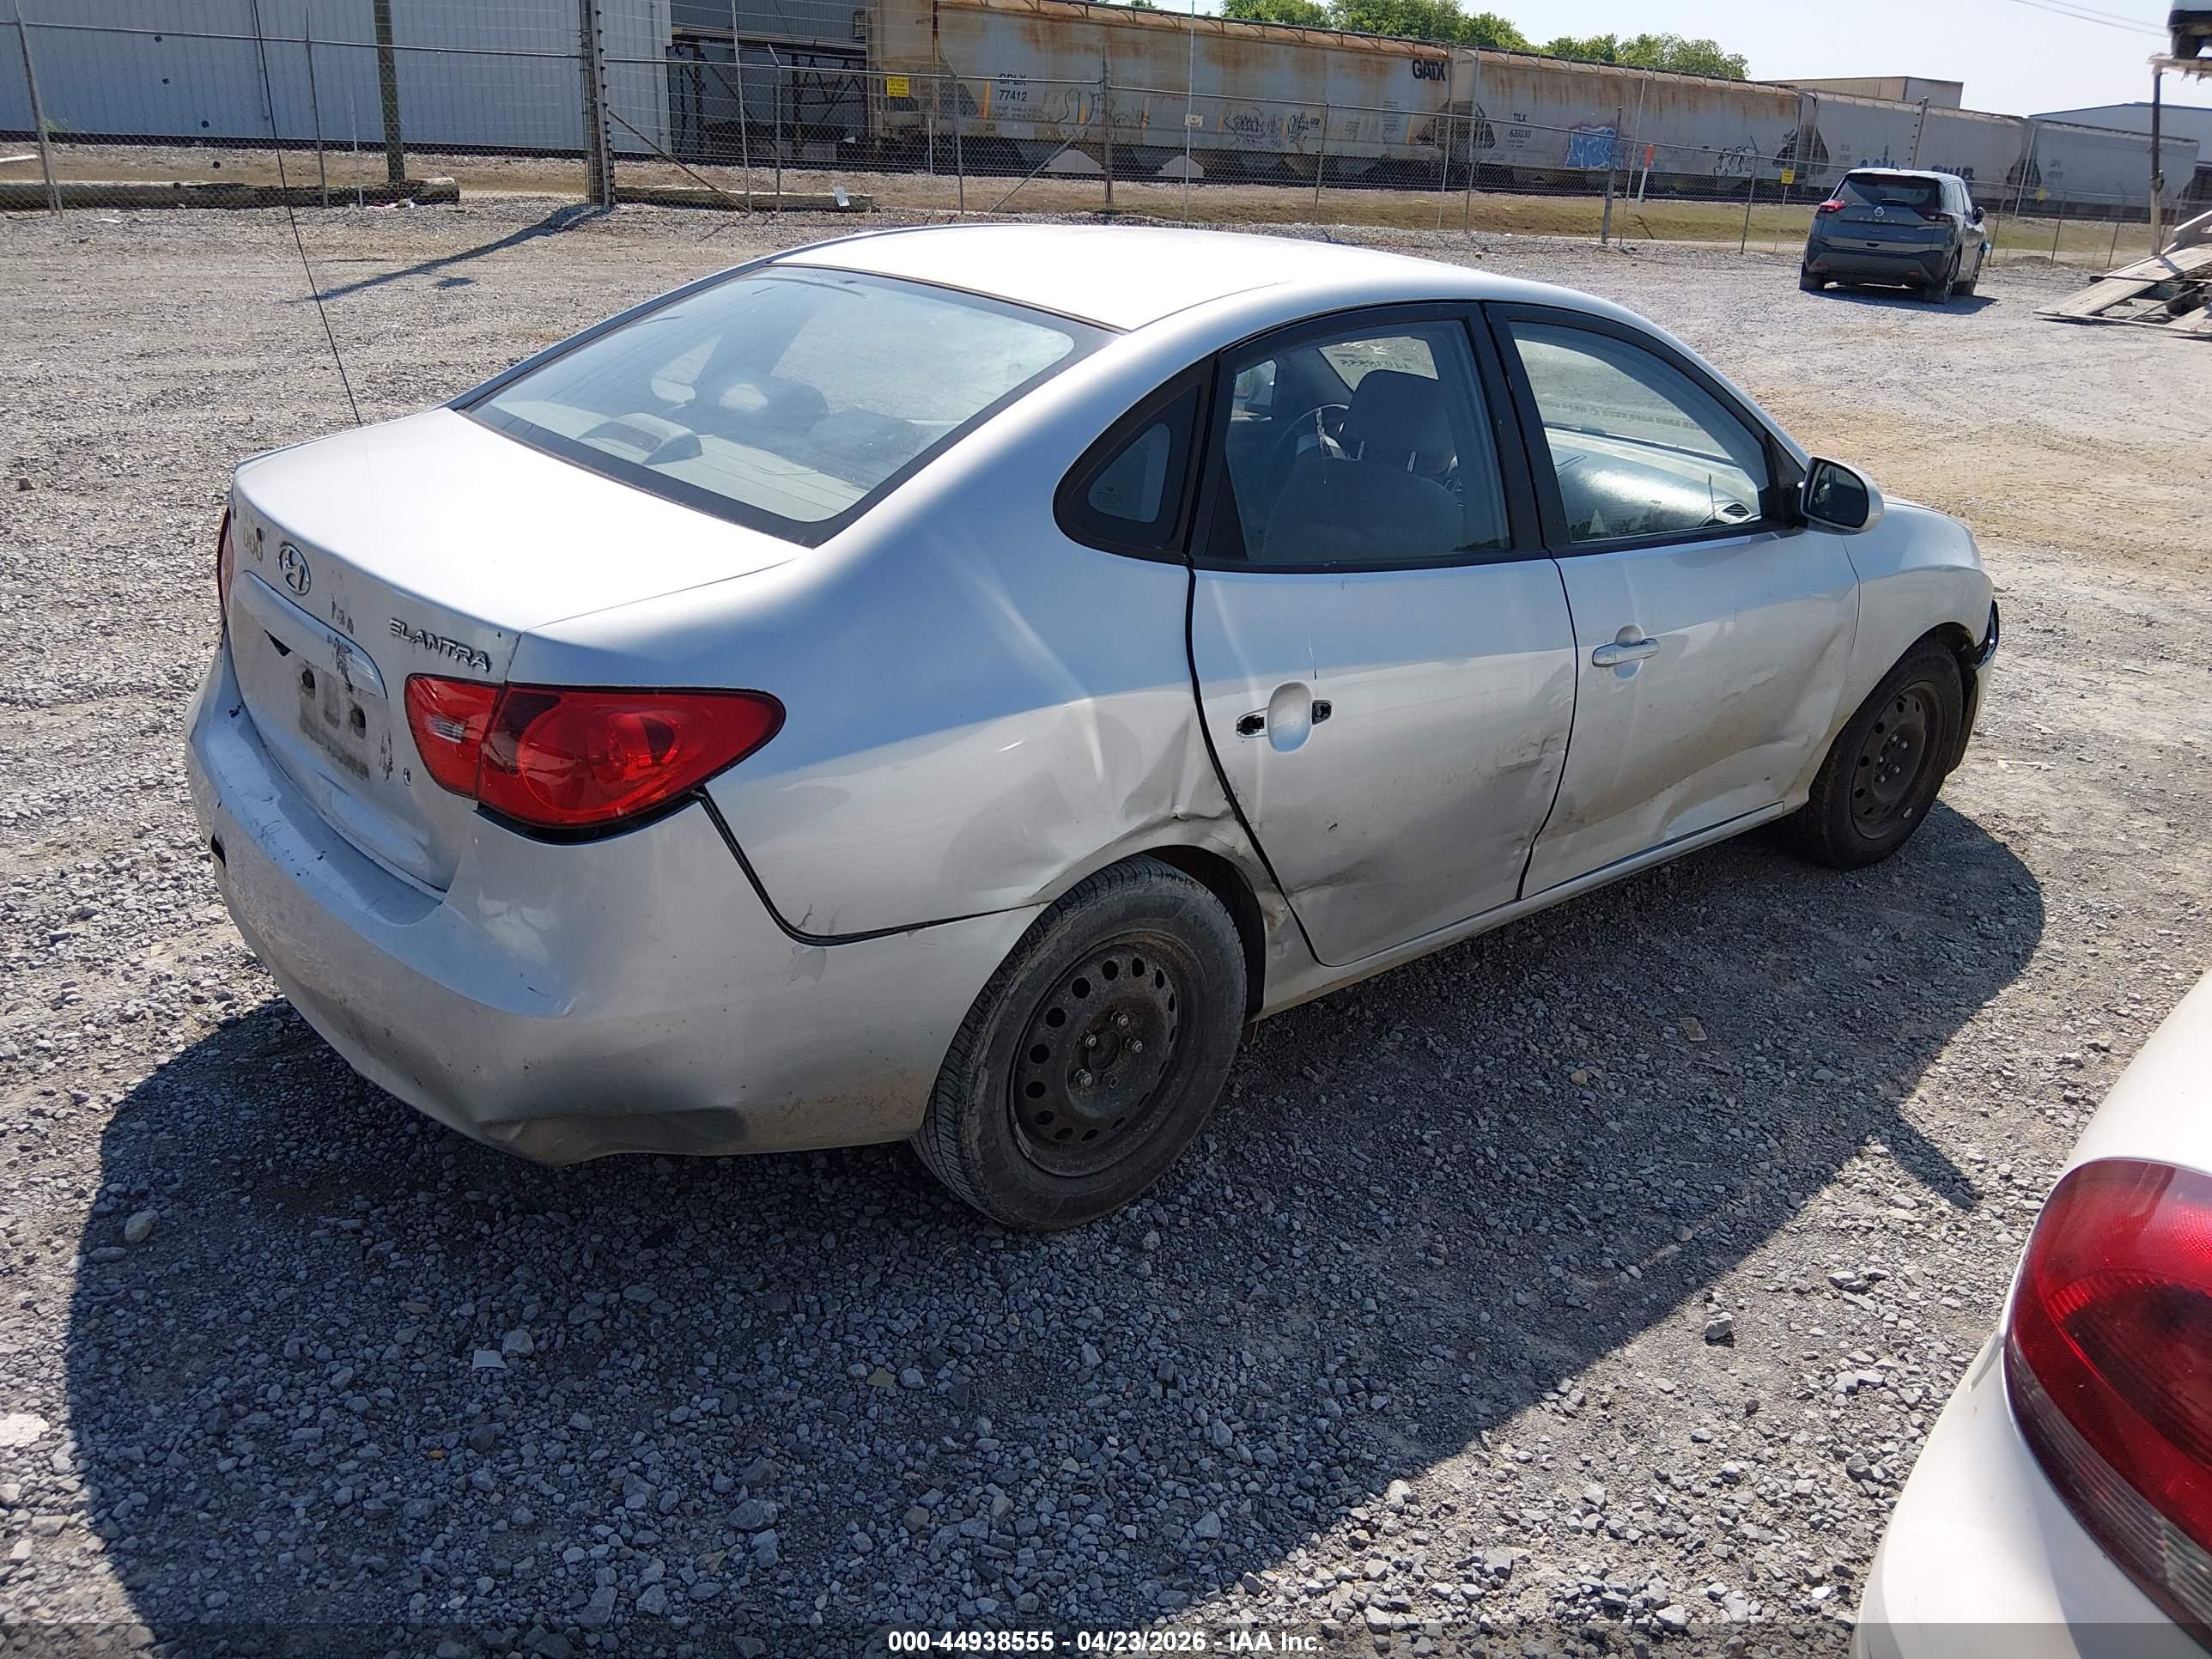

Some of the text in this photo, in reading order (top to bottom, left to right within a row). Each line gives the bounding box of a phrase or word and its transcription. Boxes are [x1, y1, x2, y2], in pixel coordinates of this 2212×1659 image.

[1412, 59, 1446, 81] GATX
[999, 89, 1027, 101] 77412
[389, 617, 490, 672] ELANTRA
